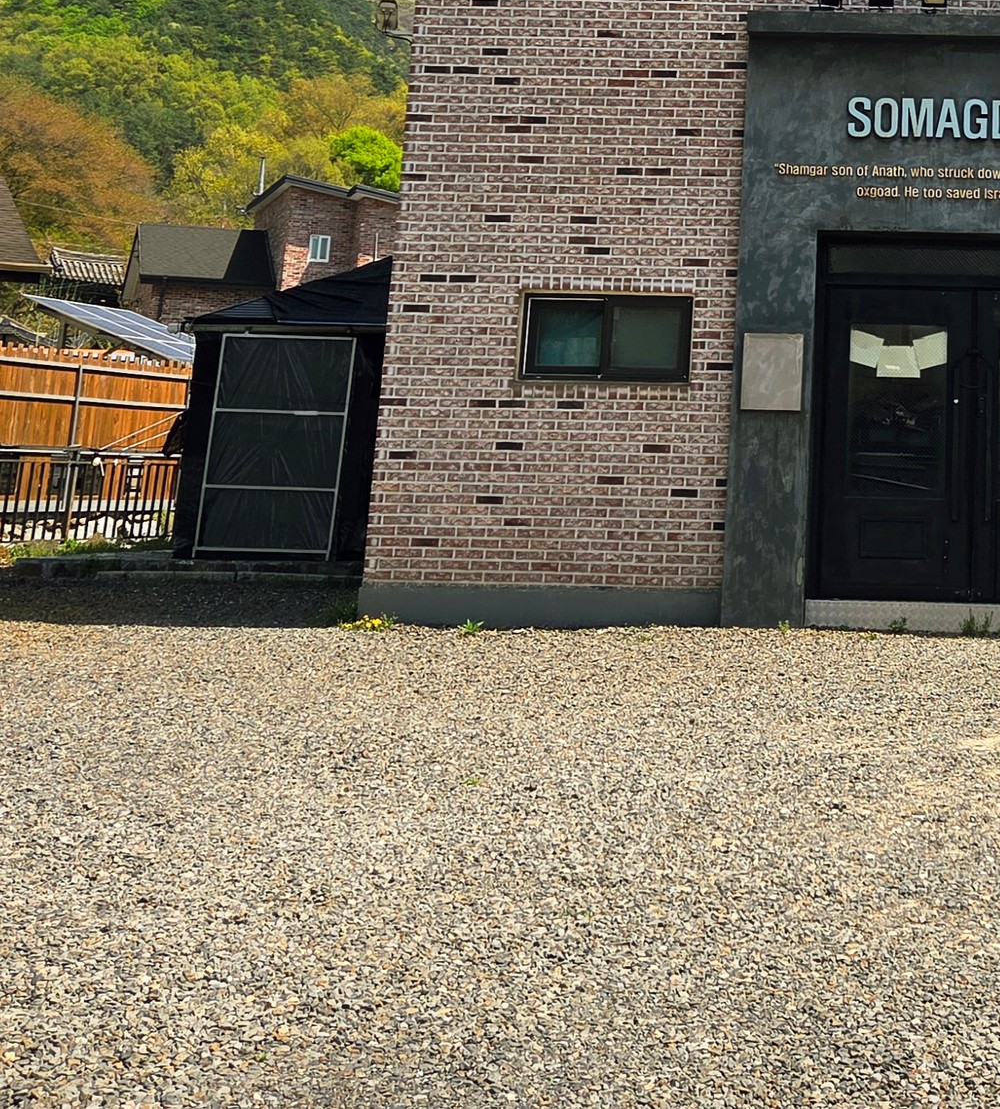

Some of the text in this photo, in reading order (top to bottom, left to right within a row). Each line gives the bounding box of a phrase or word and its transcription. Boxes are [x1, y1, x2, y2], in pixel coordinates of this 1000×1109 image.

[831, 165, 853, 176] son
[856, 165, 869, 177] of
[872, 165, 908, 178] Anath,
[910, 166, 934, 178] who
[937, 167, 975, 179] struck
[856, 186, 901, 198] oxgoad.
[904, 187, 919, 198] He
[923, 187, 943, 198] too
[946, 187, 981, 199] saved
